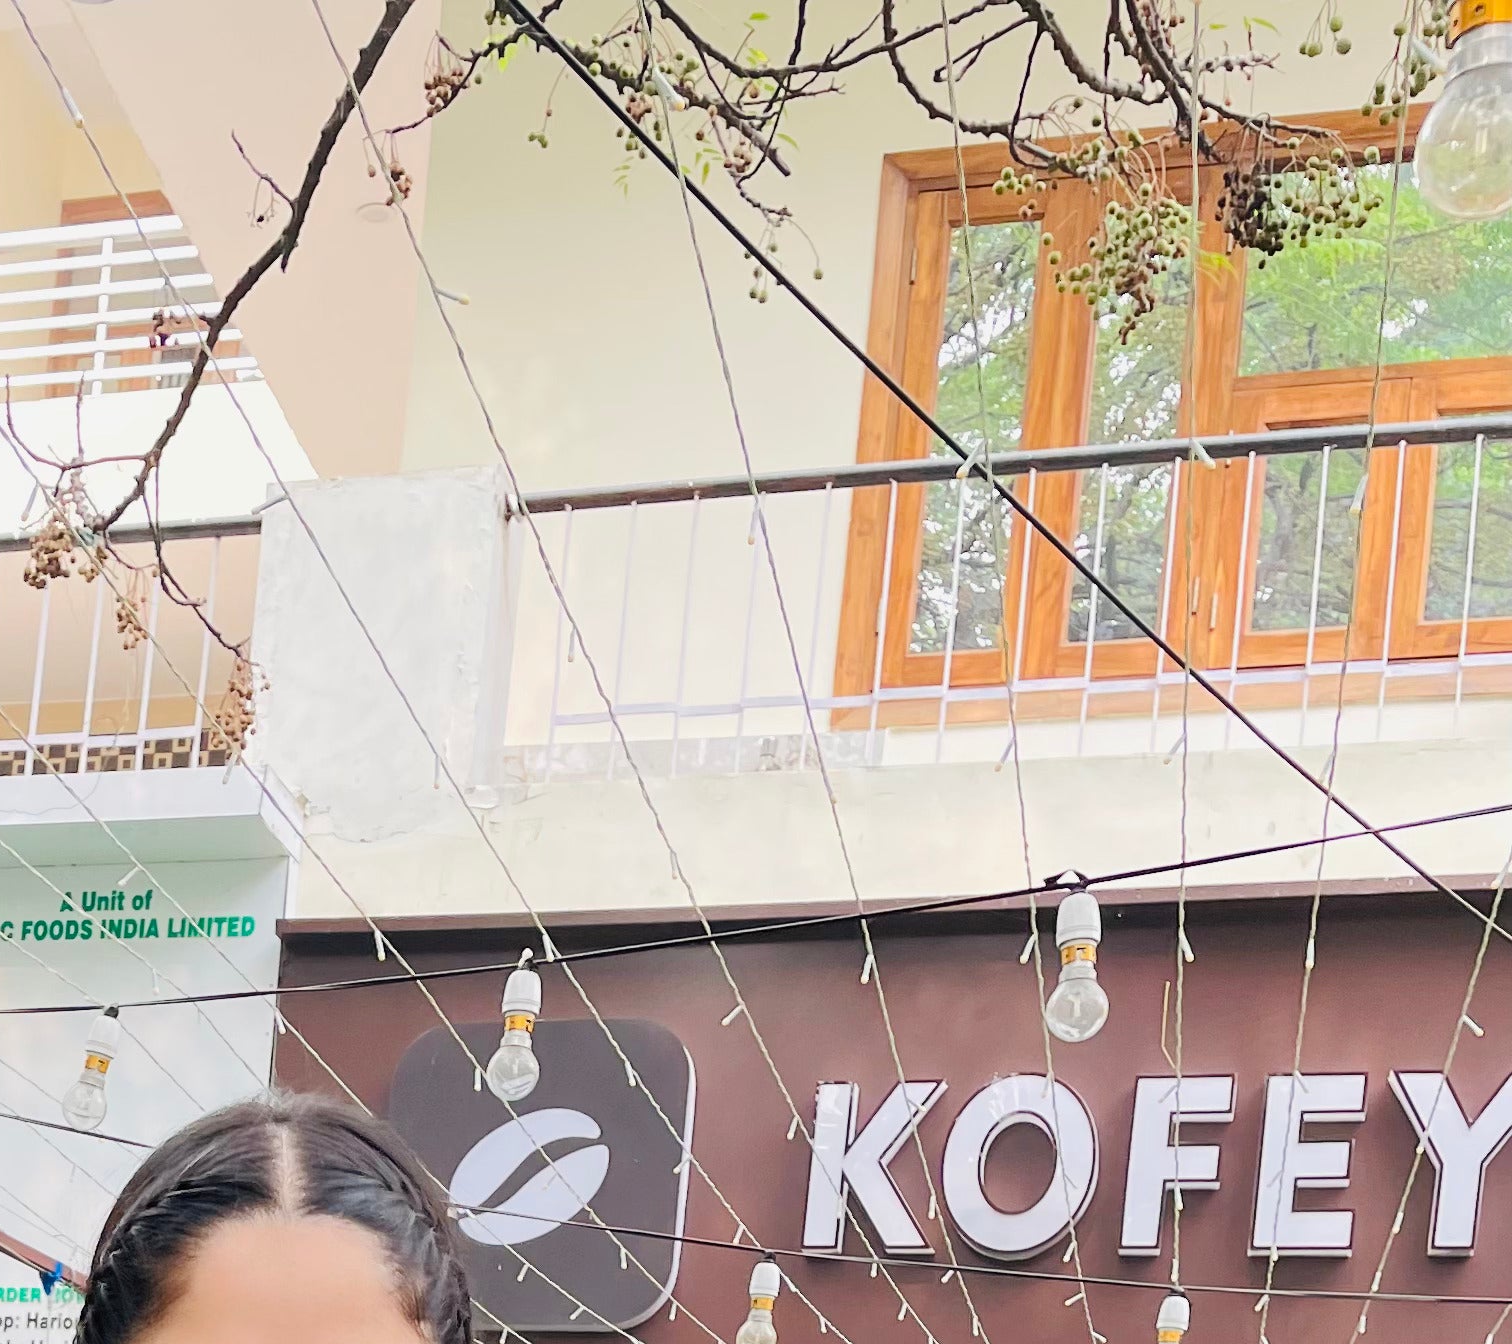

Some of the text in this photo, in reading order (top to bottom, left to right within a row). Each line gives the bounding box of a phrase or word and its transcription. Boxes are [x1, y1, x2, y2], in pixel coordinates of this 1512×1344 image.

[60, 889, 153, 912] A Unit of
[21, 919, 93, 941] FOODS
[99, 918, 159, 939] INDIA
[167, 915, 255, 938] LIMITED
[799, 1071, 1512, 1263] KOFEY
[26, 1312, 79, 1330] Hario
